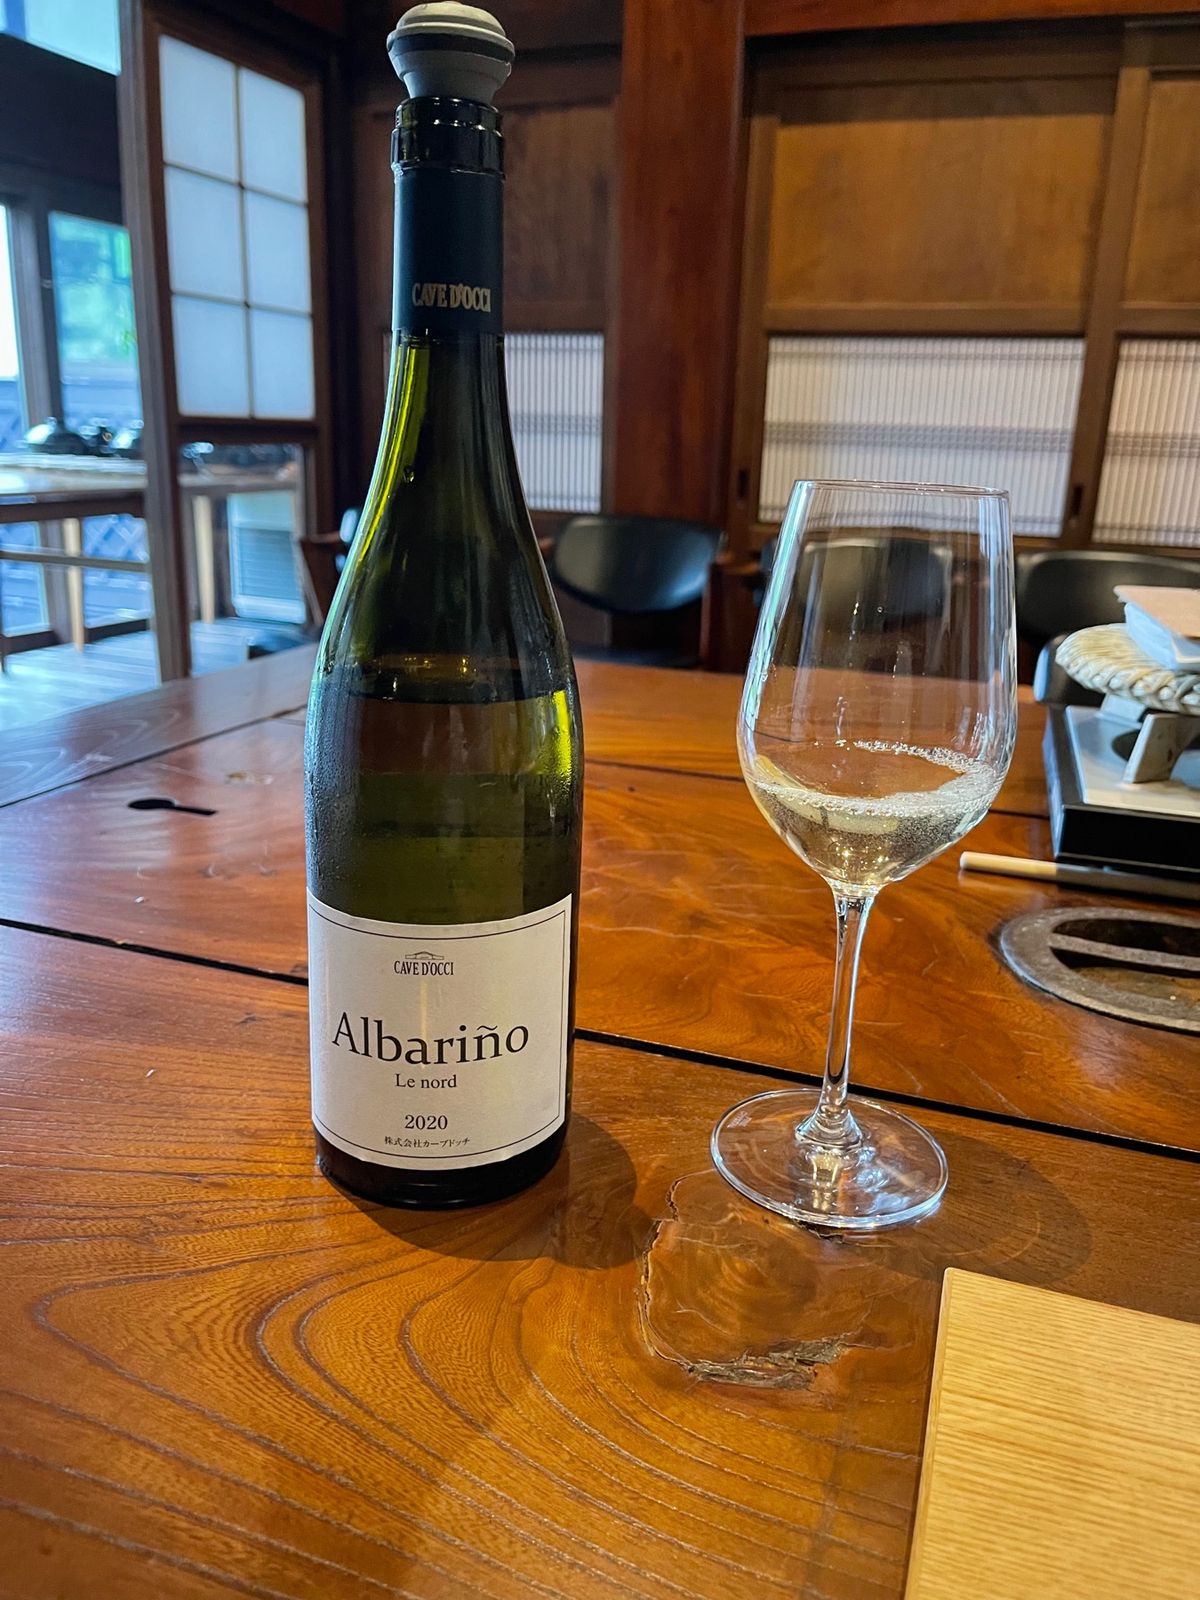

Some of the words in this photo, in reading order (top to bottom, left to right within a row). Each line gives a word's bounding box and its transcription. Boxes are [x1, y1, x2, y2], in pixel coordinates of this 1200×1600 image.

[411, 283, 447, 307] CAVE
[449, 283, 491, 312] D'OCCI
[394, 960, 419, 976] CAVE
[421, 961, 454, 976] D'OCCI
[332, 1011, 529, 1065] Albariño
[395, 1073, 416, 1088] Le
[420, 1074, 457, 1088] nord
[404, 1114, 448, 1130] 2020
